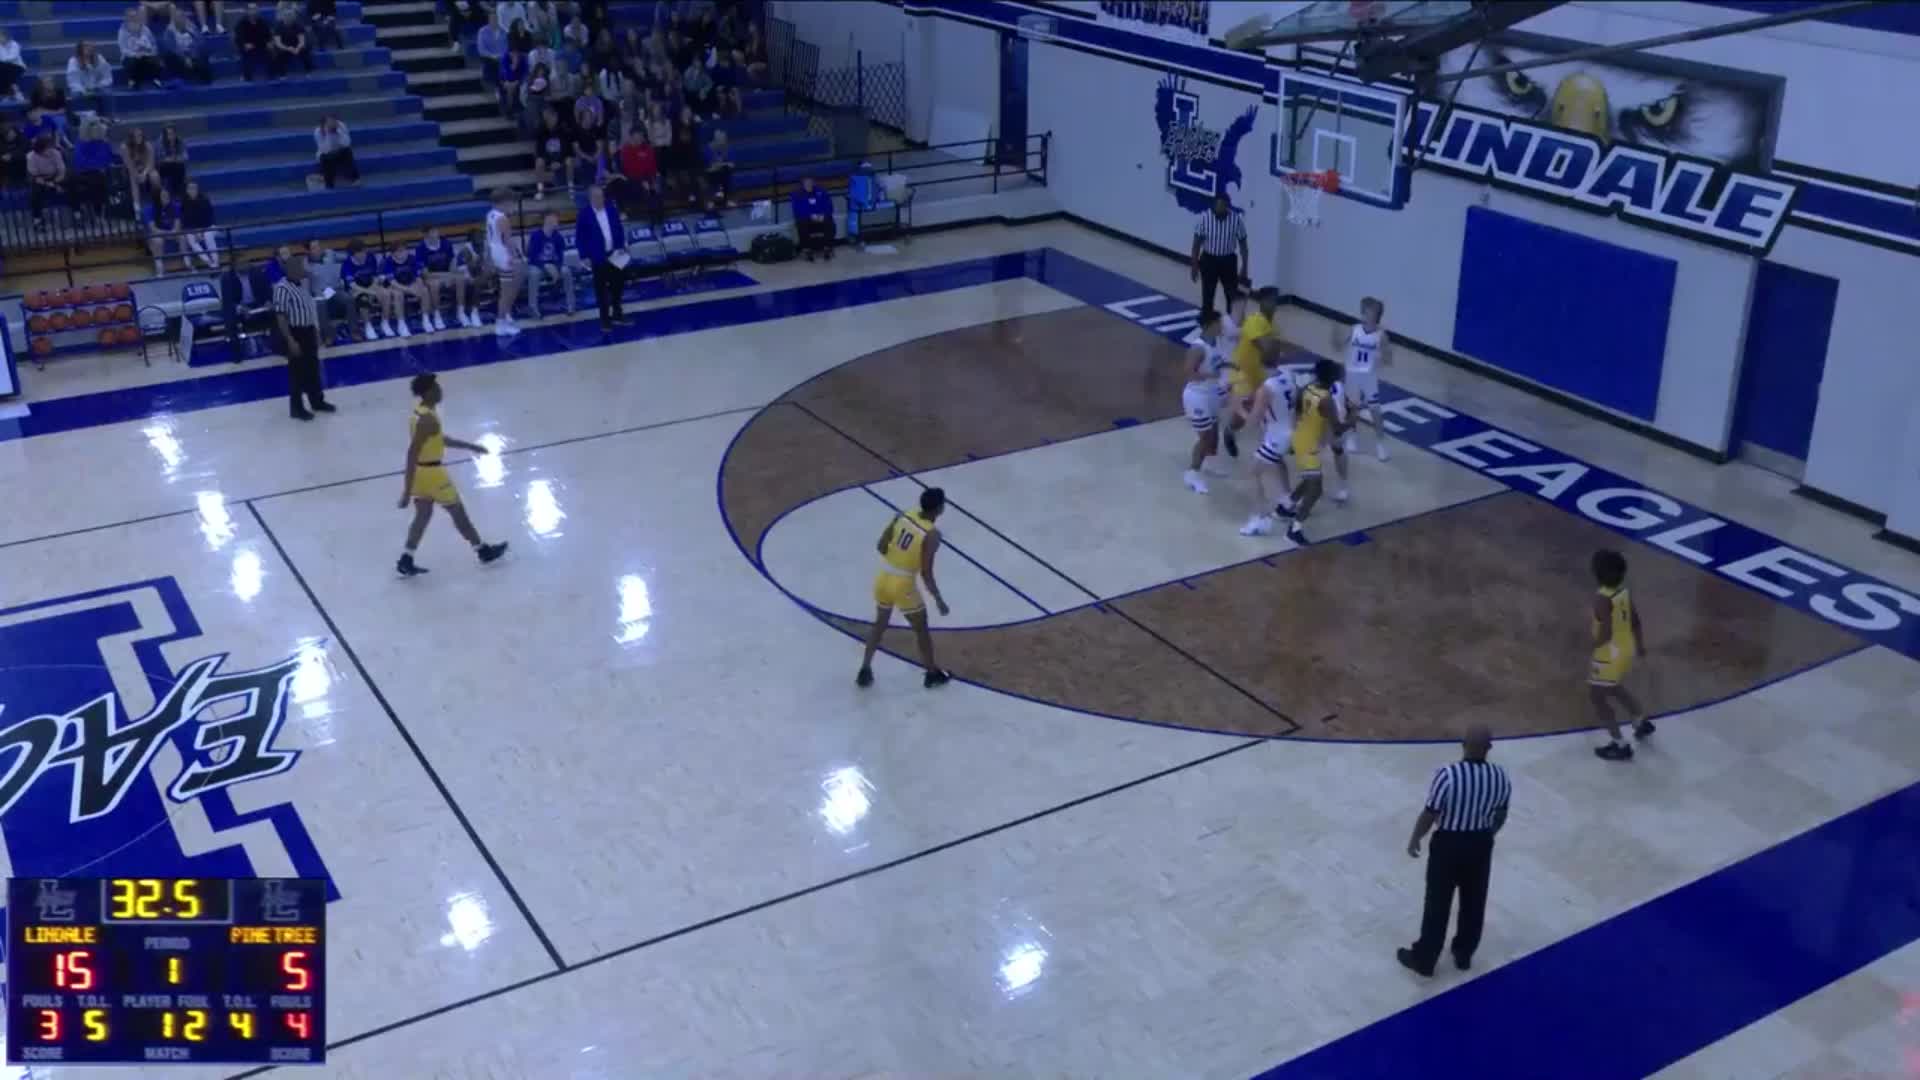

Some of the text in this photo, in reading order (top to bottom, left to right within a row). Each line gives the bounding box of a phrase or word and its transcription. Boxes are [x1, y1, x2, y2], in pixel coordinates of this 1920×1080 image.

[1401, 101, 1797, 249] LINDALE
[1357, 350, 1369, 363] 11
[897, 528, 915, 551] 10
[1430, 430, 1920, 631] EAGLES
